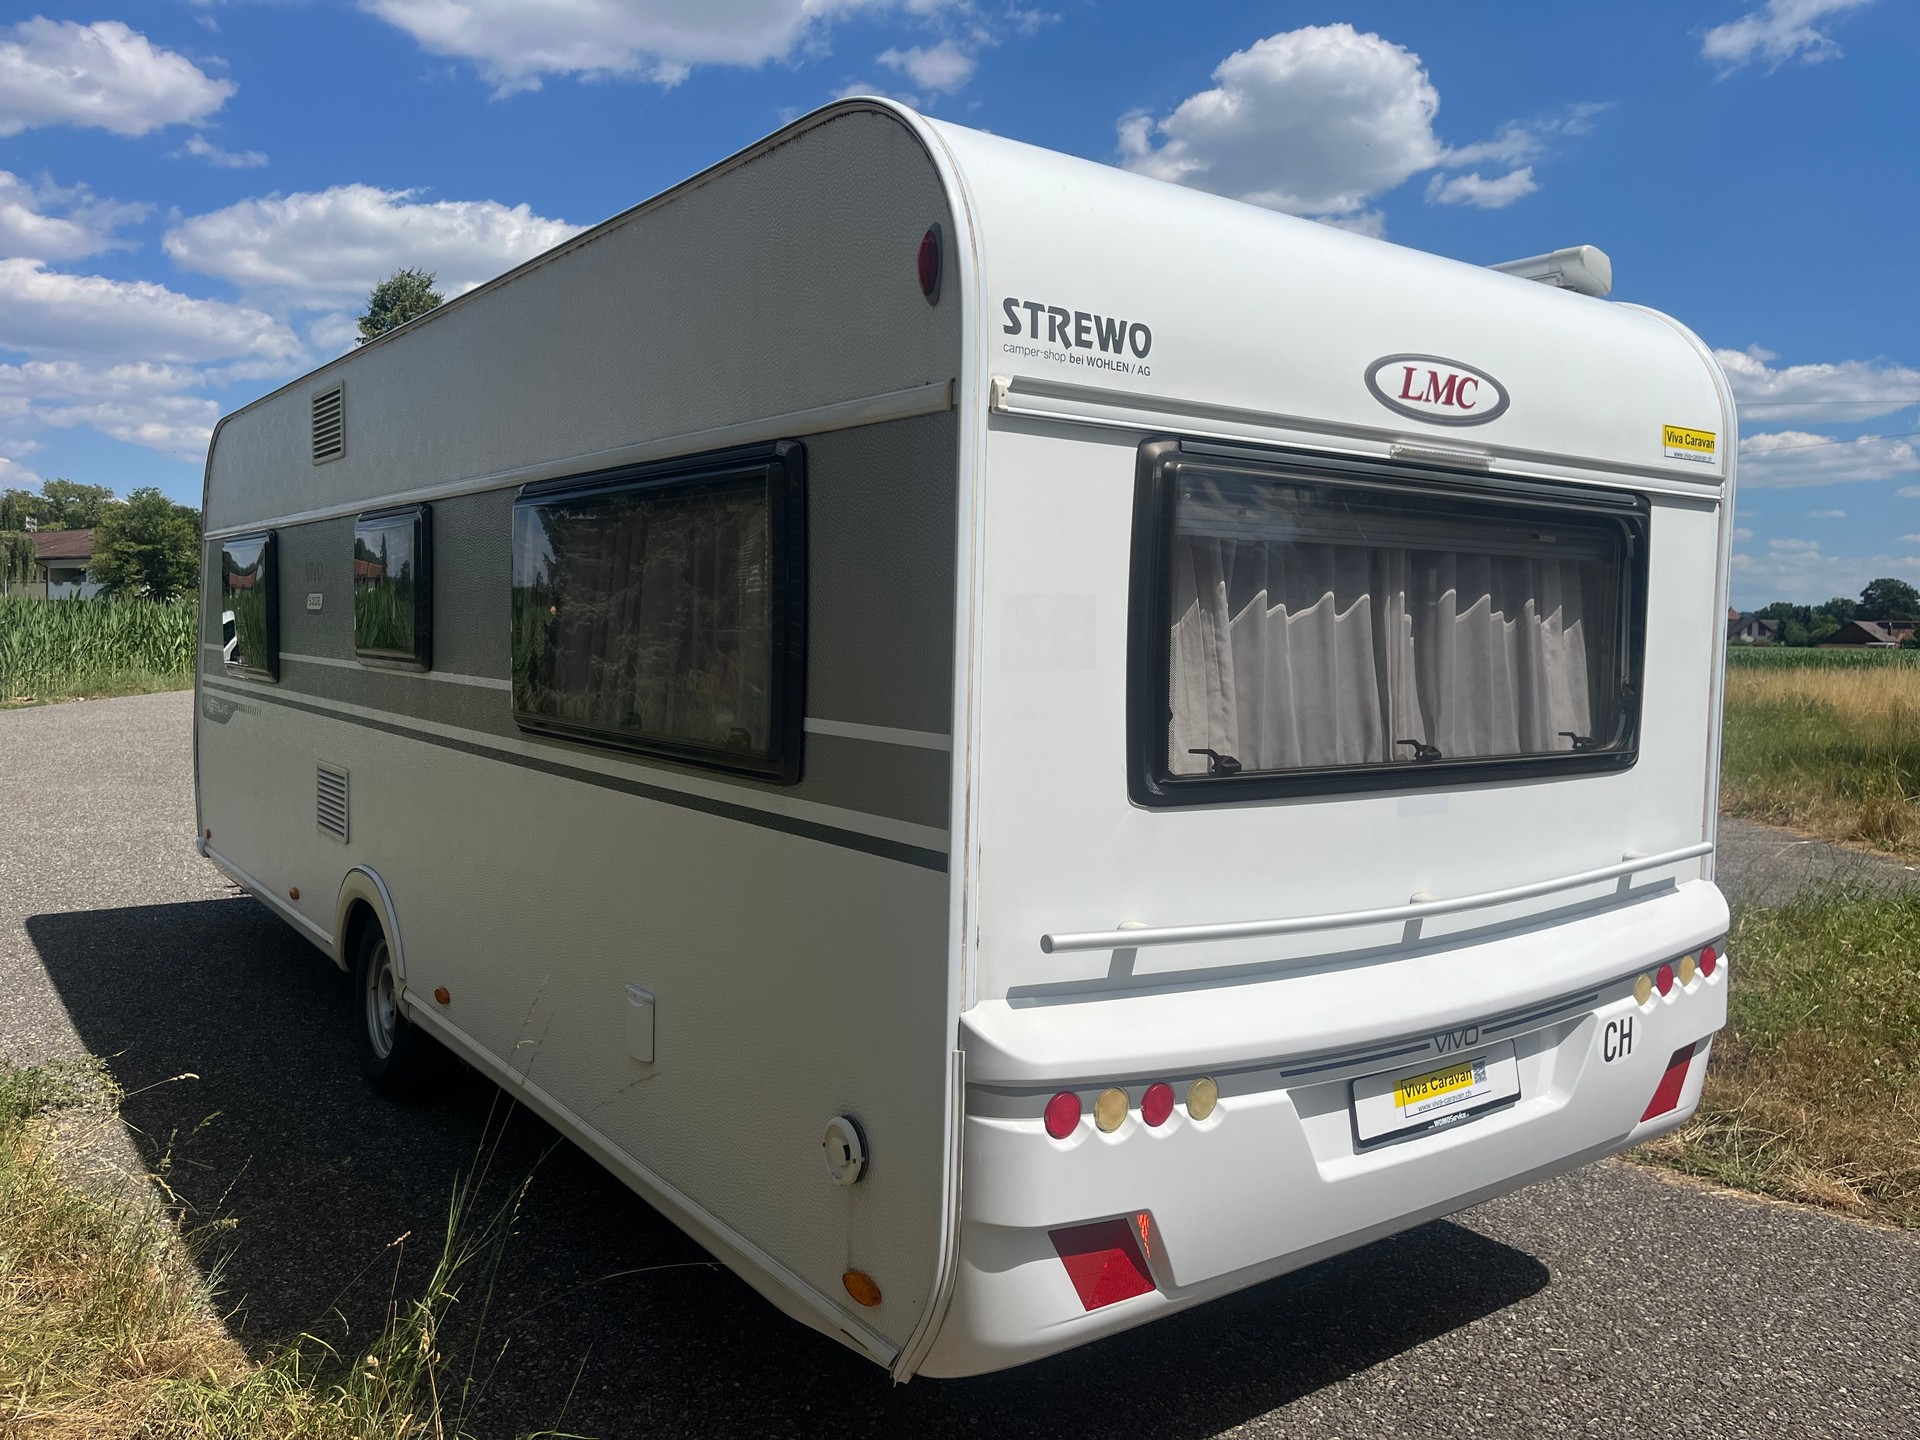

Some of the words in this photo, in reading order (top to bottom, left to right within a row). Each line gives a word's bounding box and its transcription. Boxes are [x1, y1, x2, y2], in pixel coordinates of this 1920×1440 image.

[1003, 297, 1152, 359] STREWO
[1003, 343, 1066, 363] camper-shop
[1069, 352, 1084, 366] bei
[1086, 355, 1129, 373] WOHLEN
[1137, 365, 1151, 376] AG
[1398, 366, 1479, 410] LMC
[1666, 430, 1683, 444] Viva
[1685, 433, 1715, 450] Caravan
[1433, 1026, 1479, 1053] VIVO
[1603, 1016, 1633, 1063] CH
[1404, 1082, 1428, 1098] Viva
[1430, 1069, 1473, 1091] Caravan
[1417, 1089, 1473, 1112] www.viva-caravan.ch
